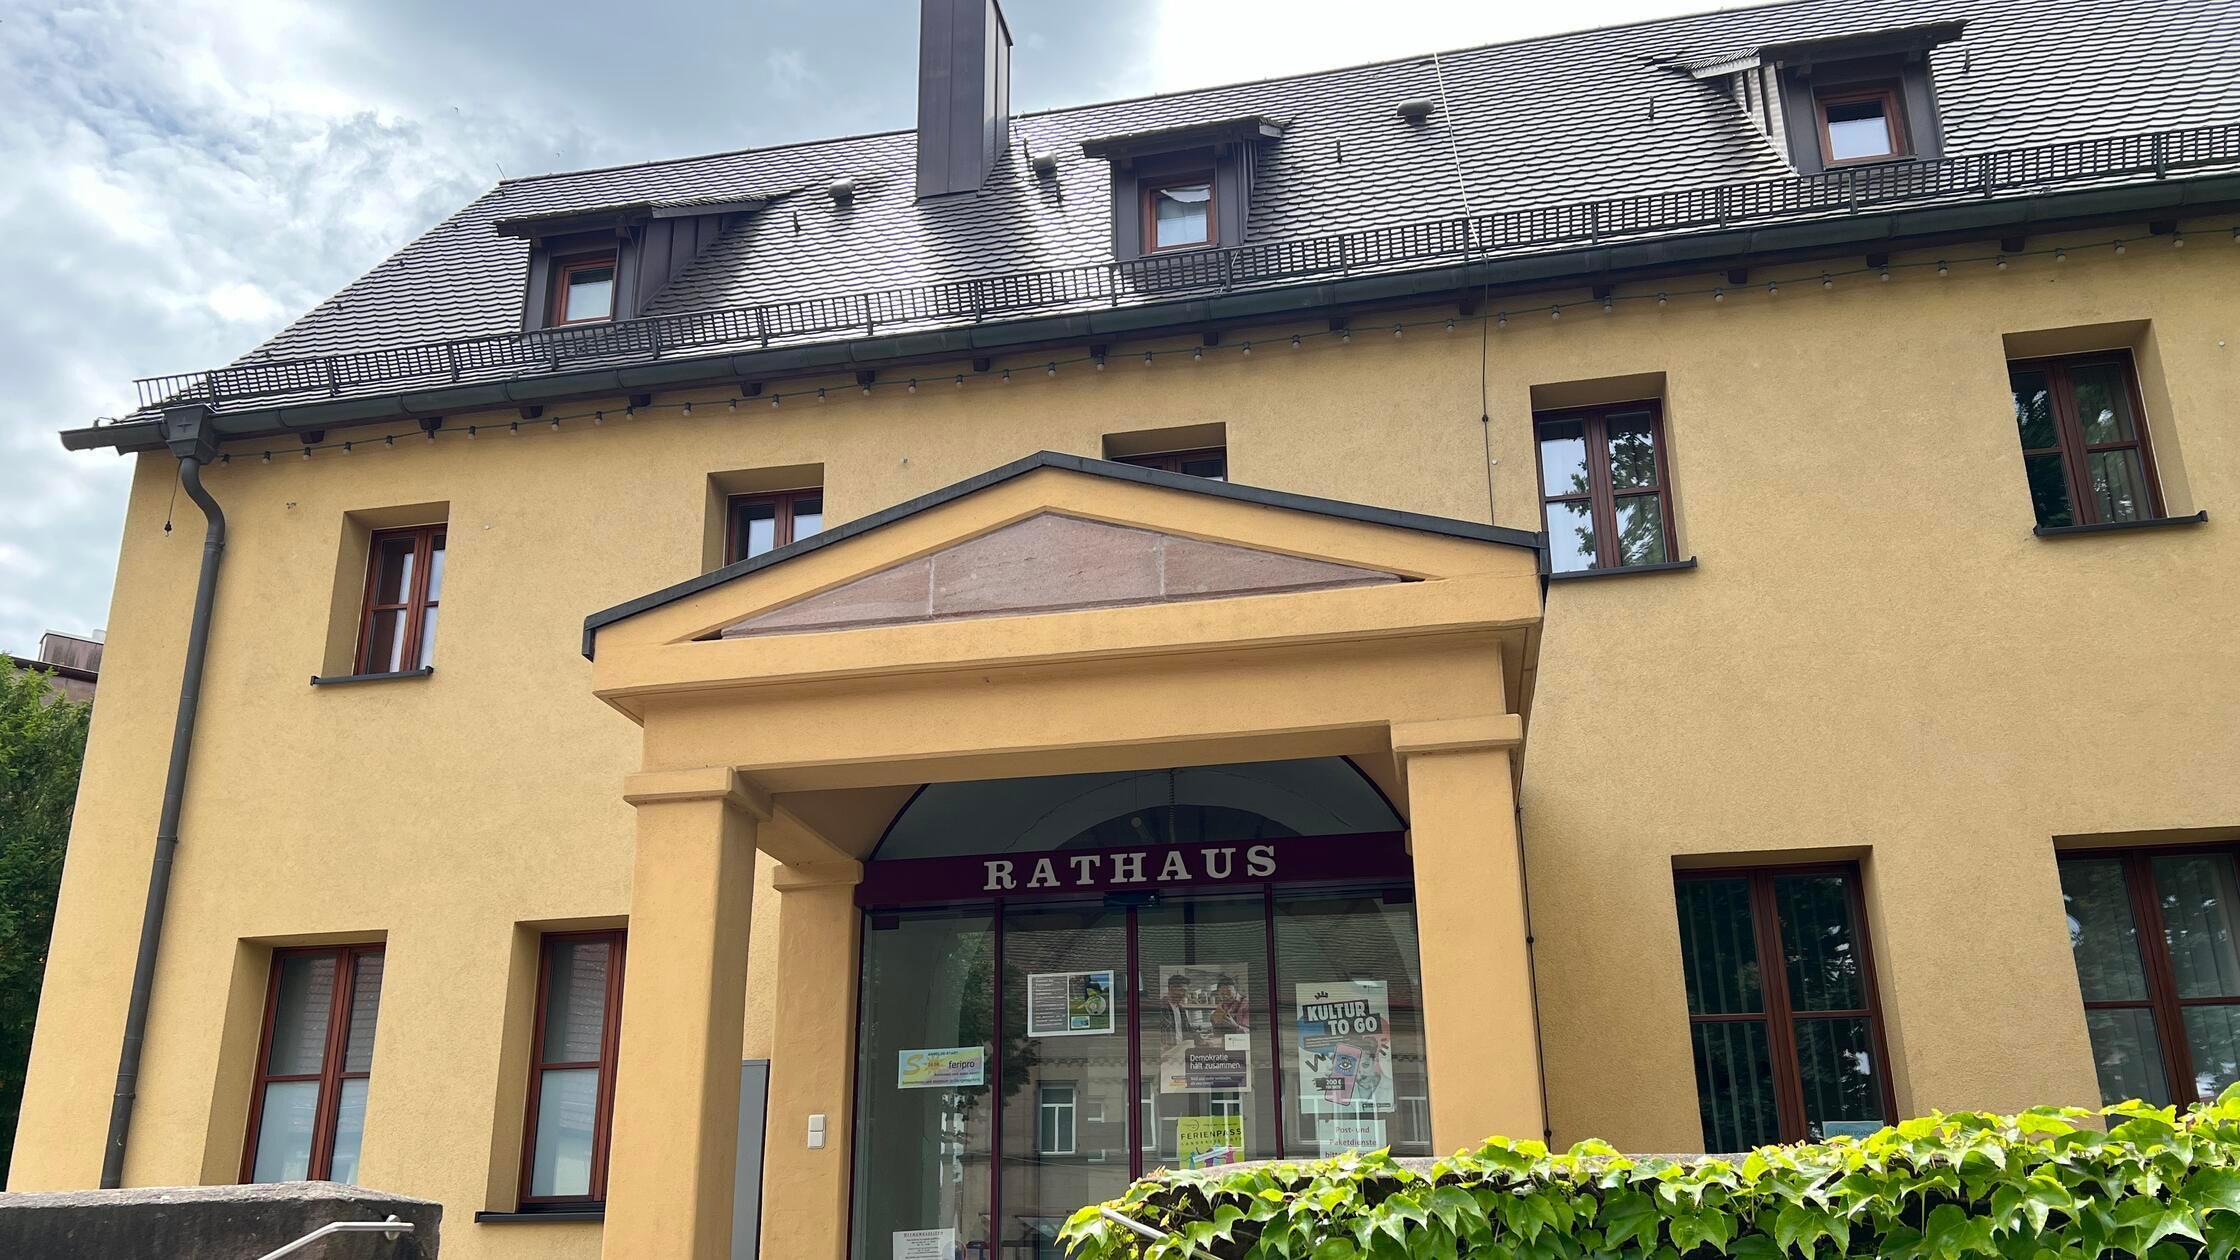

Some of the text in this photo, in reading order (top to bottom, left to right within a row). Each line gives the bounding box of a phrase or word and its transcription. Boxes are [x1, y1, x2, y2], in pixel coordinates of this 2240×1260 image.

[983, 845, 1277, 891] RATHAUS
[1307, 1001, 1366, 1022] KULTUR
[1328, 1016, 1378, 1036] TO GO
[1190, 1053, 1229, 1062] Demokratie
[948, 1060, 975, 1070] feripro
[1205, 1062, 1241, 1070] zusammen
[1180, 1128, 1242, 1140] FERIENPASS
[1329, 1138, 1377, 1146] Paketdienste
